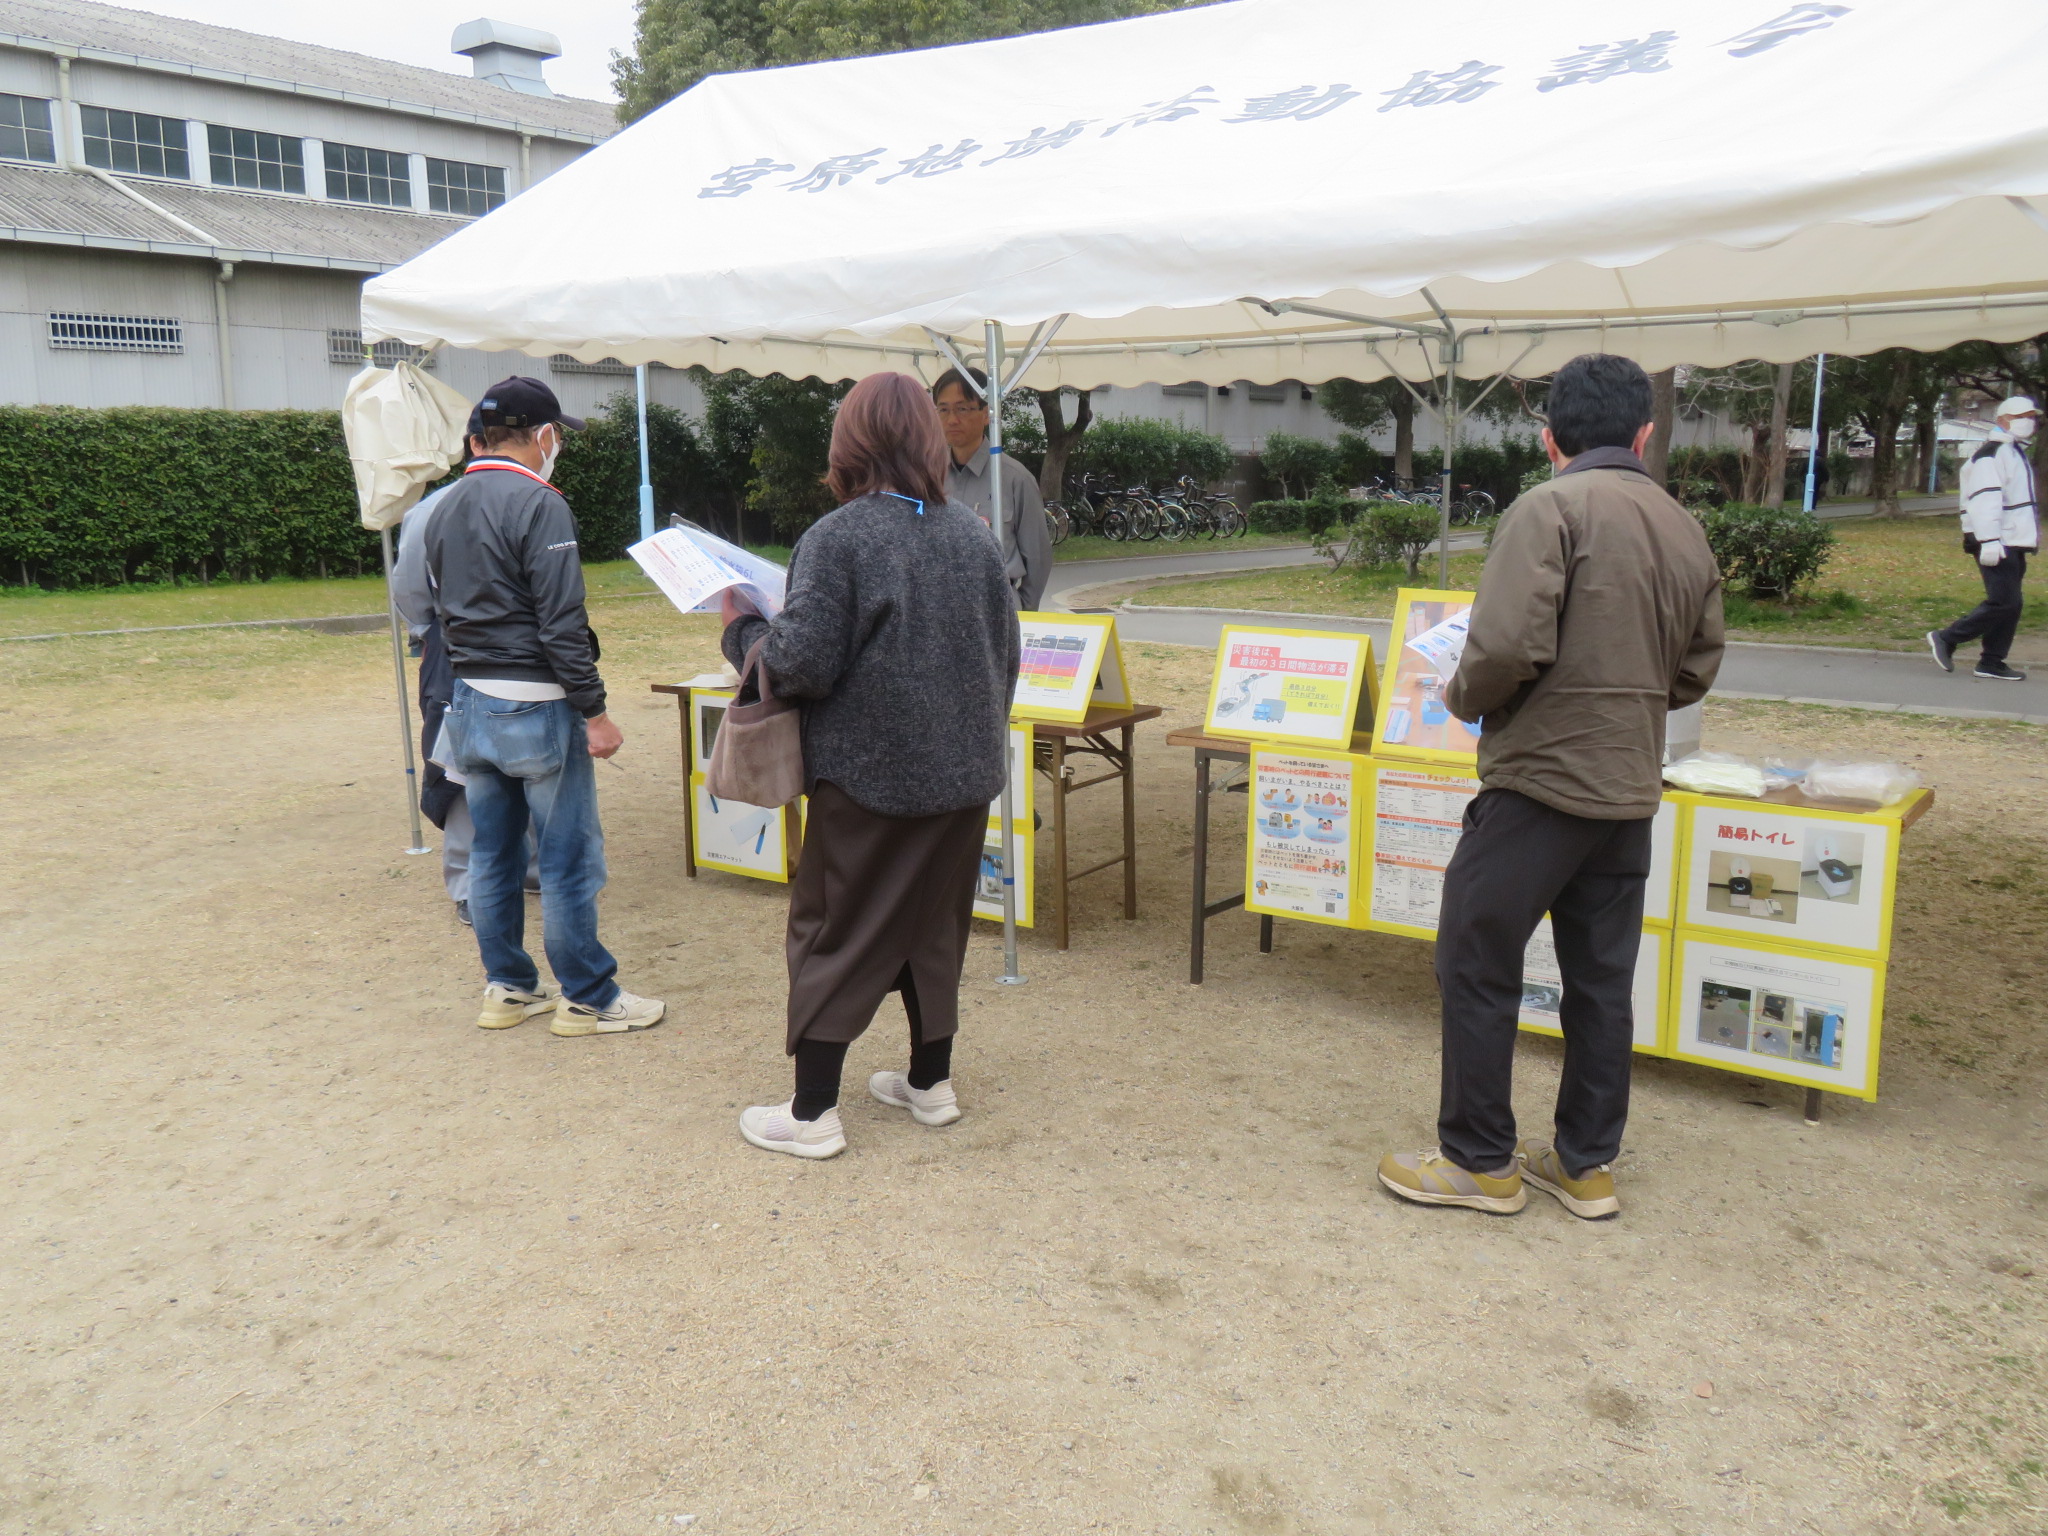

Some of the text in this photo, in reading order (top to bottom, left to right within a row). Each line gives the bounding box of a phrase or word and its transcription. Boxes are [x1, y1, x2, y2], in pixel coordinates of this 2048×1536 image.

[697, 3, 1854, 199] 宮原地域活動協議会
[1232, 644, 1274, 657] 災害後は、
[1239, 656, 1347, 674] 最初の3日間物流が滞る
[1717, 824, 1796, 846] 簡易トイレ
